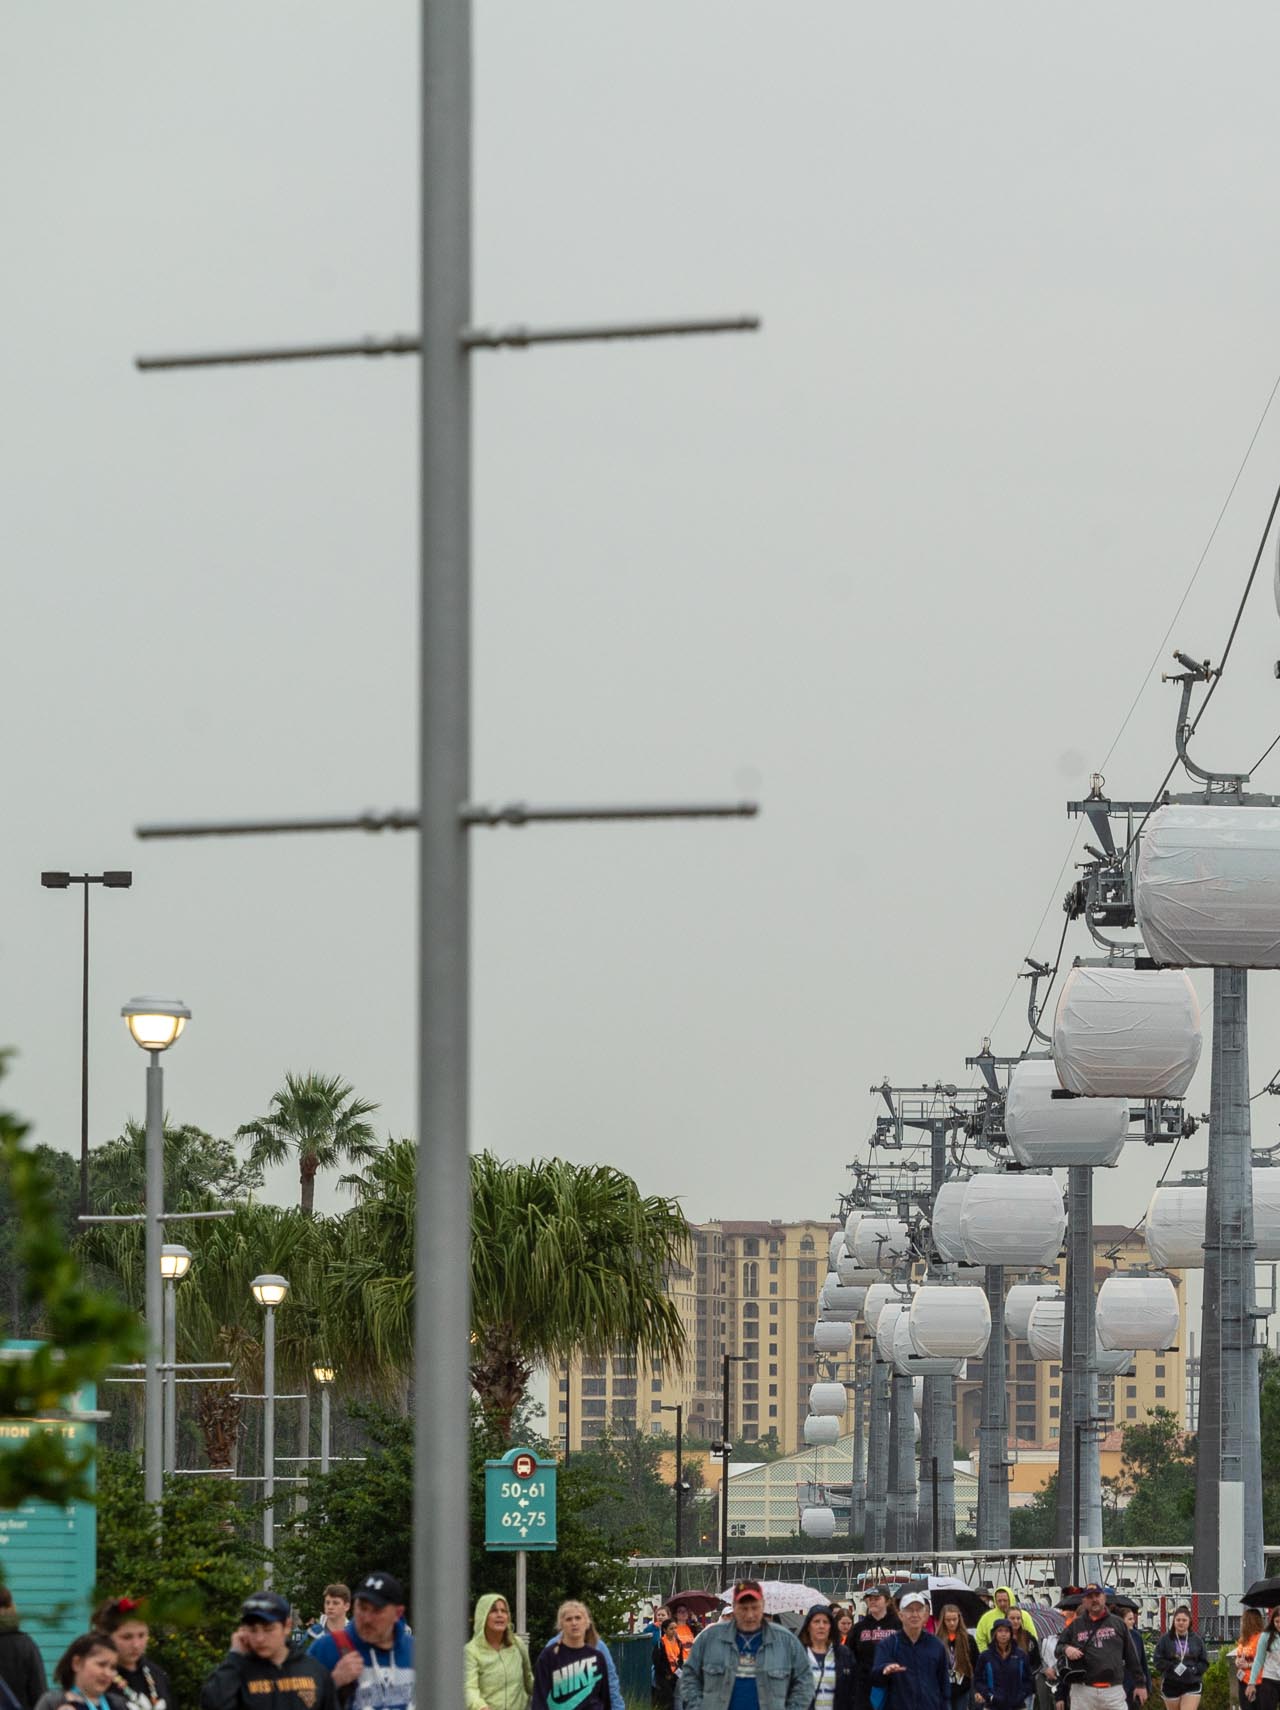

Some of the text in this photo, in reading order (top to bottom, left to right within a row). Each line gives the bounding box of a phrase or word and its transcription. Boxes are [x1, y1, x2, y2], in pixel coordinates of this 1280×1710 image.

[501, 1482, 546, 1498] 50-61
[501, 1511, 547, 1527] 62-75
[277, 1676, 317, 1692] VIRGINIA
[552, 1655, 598, 1699] NIKE
